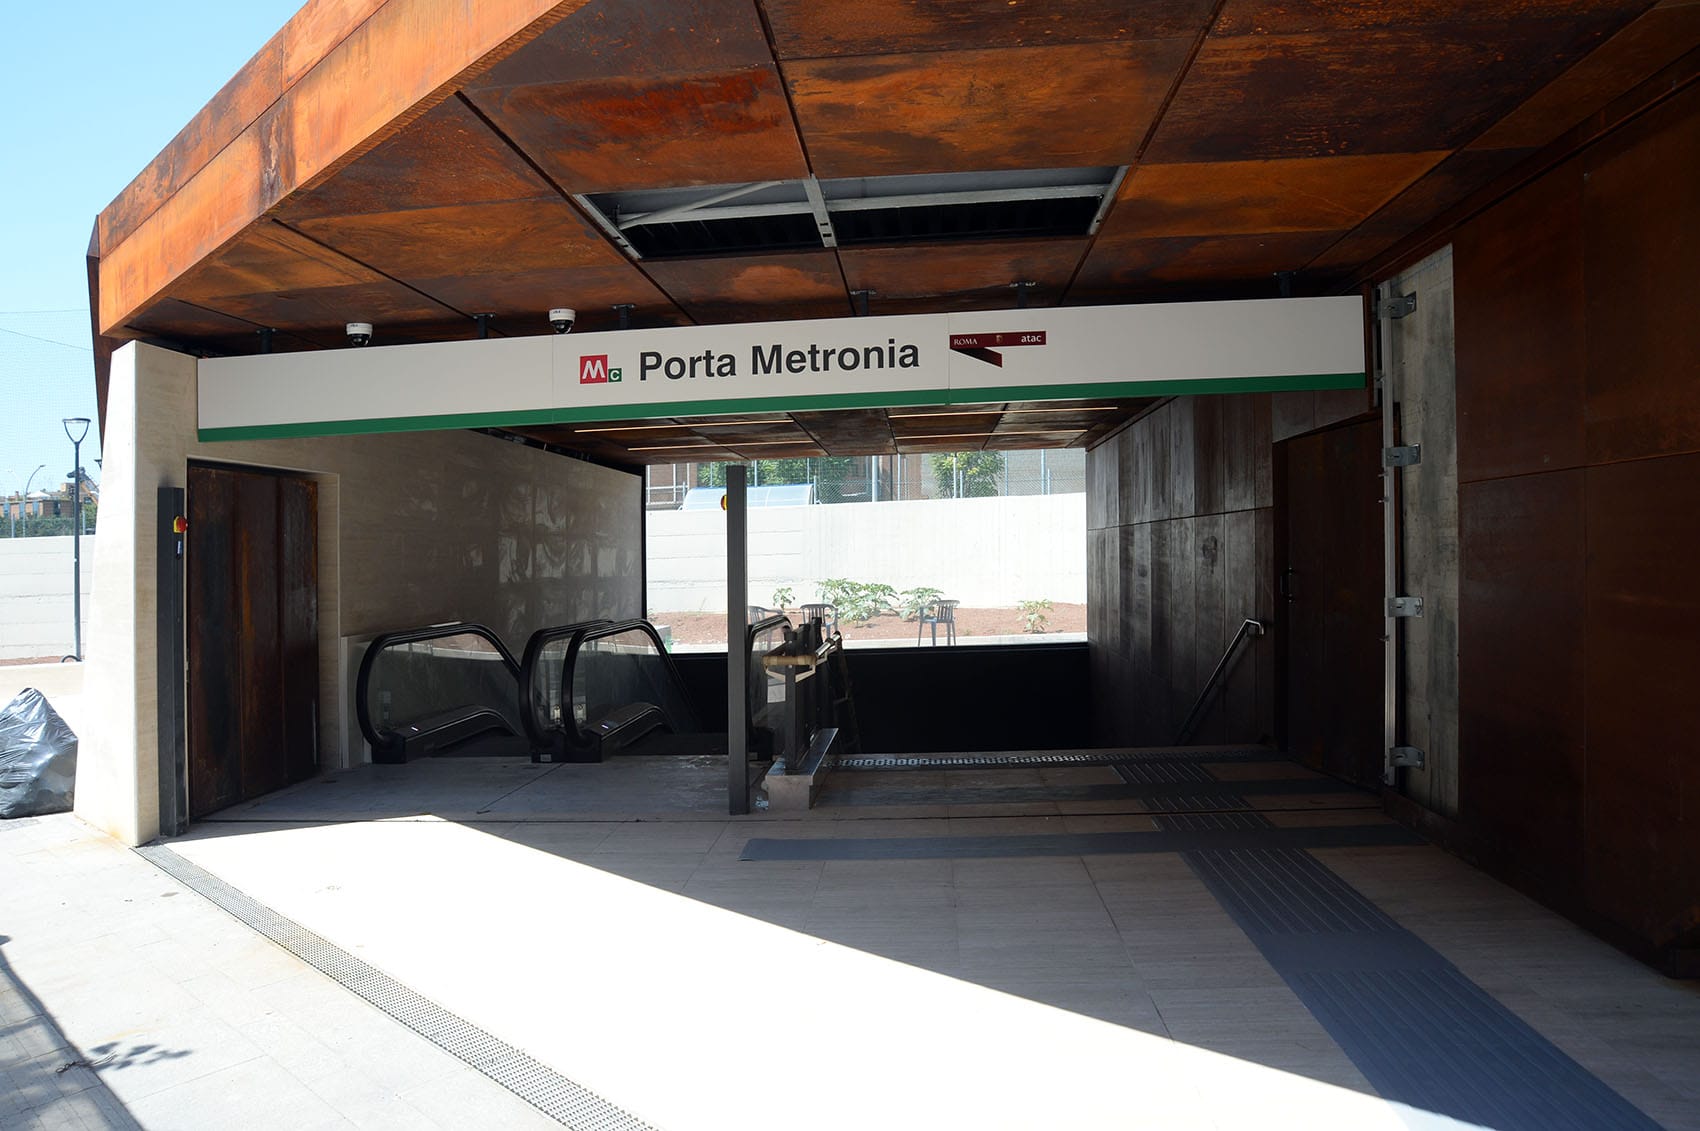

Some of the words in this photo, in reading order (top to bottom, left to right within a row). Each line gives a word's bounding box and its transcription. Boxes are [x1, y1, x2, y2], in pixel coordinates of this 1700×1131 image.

[1021, 335, 1041, 343] atac
[640, 350, 736, 381] Porta
[752, 338, 920, 375] Metronia
[582, 360, 606, 379] M
